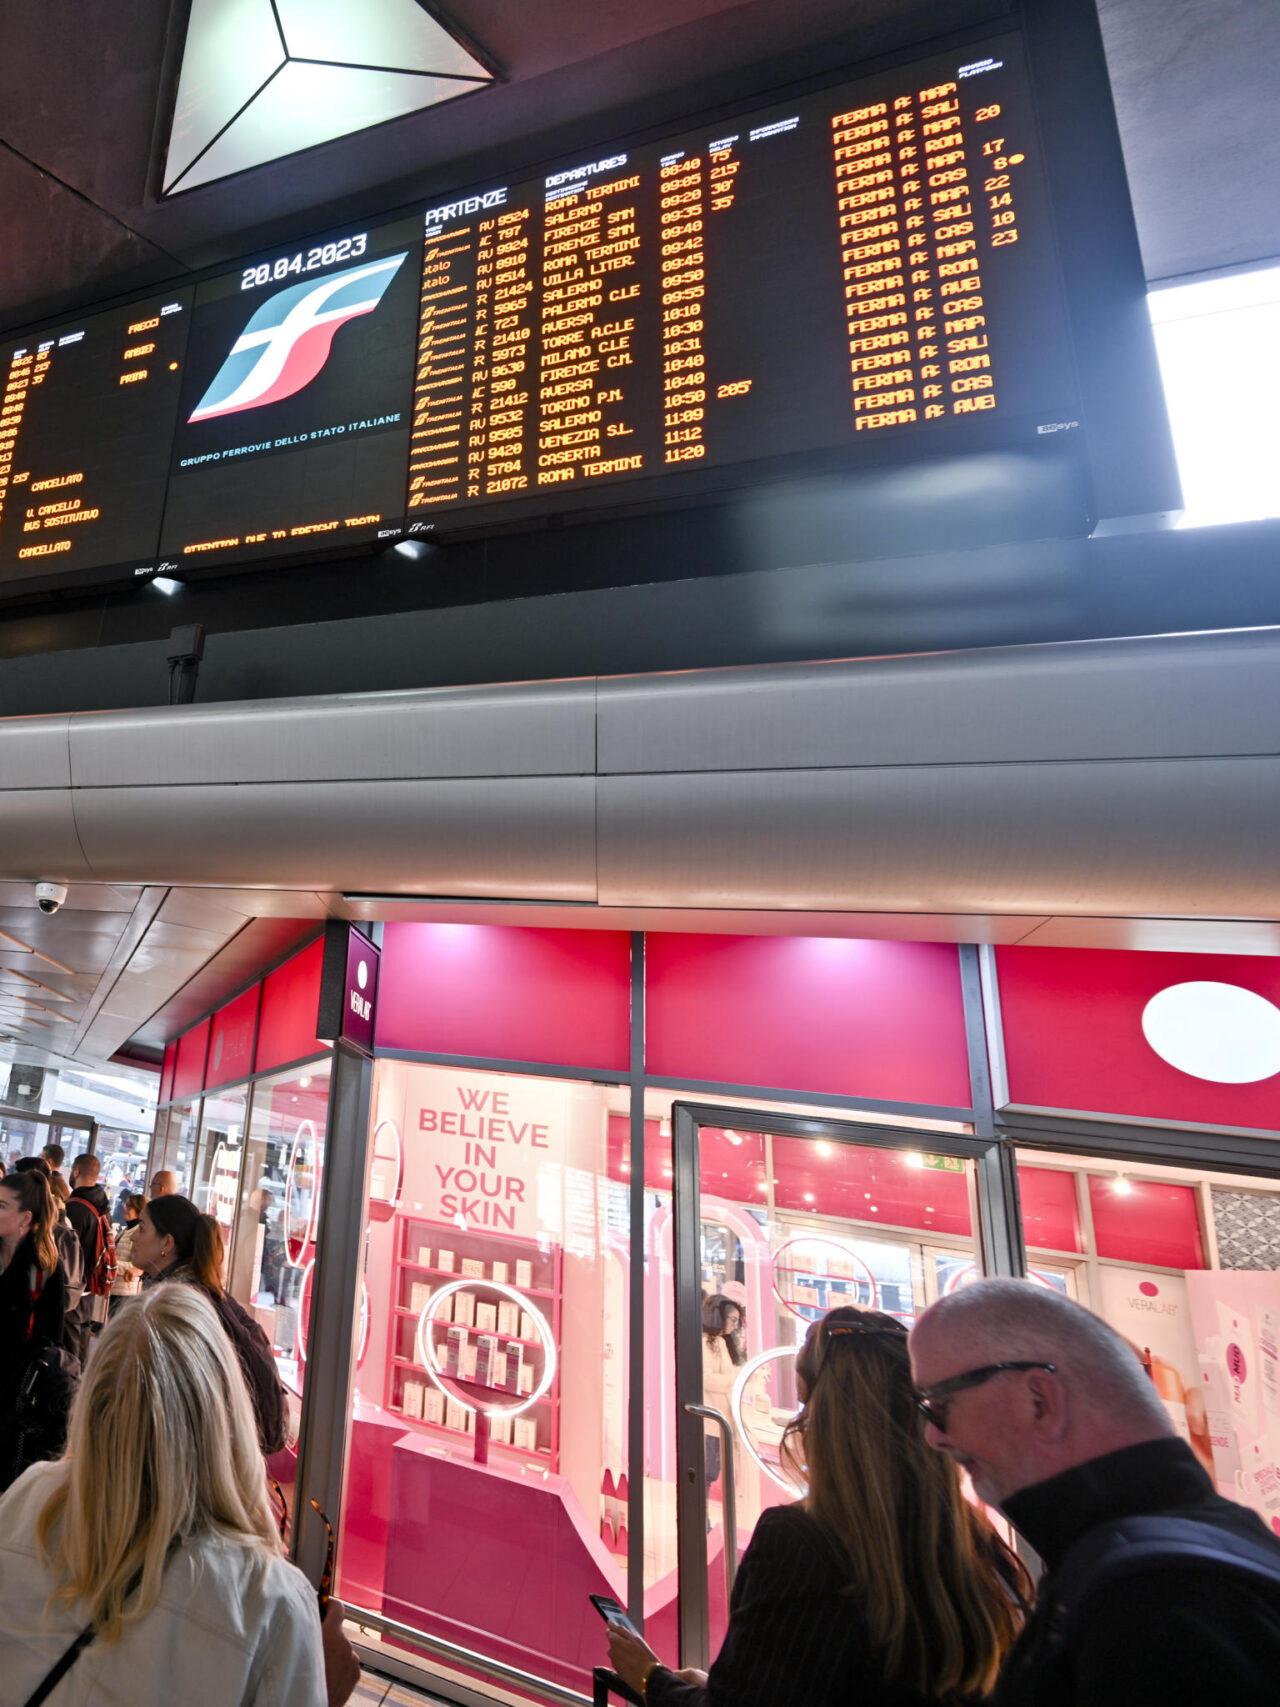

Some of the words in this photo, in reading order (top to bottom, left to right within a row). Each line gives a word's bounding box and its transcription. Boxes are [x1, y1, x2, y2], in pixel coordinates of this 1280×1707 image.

[477, 248, 494, 262] AV
[496, 237, 529, 256] 9924
[544, 216, 601, 242] FIRENZE
[607, 207, 635, 224] SMN
[660, 188, 702, 209] 09:20
[834, 135, 891, 161] FERMA
[975, 104, 1001, 122] 20
[479, 219, 495, 233] AV
[497, 208, 530, 227] 9524
[544, 194, 579, 213] ROMA
[585, 175, 640, 201] TERMINI
[660, 157, 701, 179] 08:40
[831, 102, 887, 129] FERMA
[479, 234, 492, 247] IC
[497, 224, 522, 241] 797
[544, 201, 603, 227] SALERNO
[660, 172, 702, 194] 09:05
[832, 119, 889, 145] FERMA
[545, 153, 629, 188] DEPARTURES
[425, 187, 508, 226] PARTENZE
[476, 262, 494, 276] AV
[495, 252, 527, 270] 8910
[543, 231, 601, 257] FIRENZE
[607, 222, 635, 239] SMN
[660, 203, 703, 225] 09:35
[835, 152, 892, 178] FERMA
[476, 277, 493, 291] AV
[495, 267, 526, 285] 9514
[543, 254, 578, 273] ROMA
[584, 236, 641, 261] TERMINI
[661, 219, 703, 241] 09:40
[836, 169, 894, 195] FERMA
[982, 138, 1005, 156] 17
[476, 293, 488, 306] R
[494, 280, 534, 301] 21424
[542, 267, 584, 287] VILLA
[661, 236, 704, 257] 09:42
[838, 186, 896, 211] FERMA
[993, 156, 1008, 171] 8
[240, 233, 368, 291] 20.04.2023
[474, 323, 489, 337] IC
[493, 314, 519, 331] 723
[541, 294, 603, 319] PALERMO
[661, 268, 705, 289] 09:50
[840, 220, 899, 246] FERMA
[989, 192, 1013, 210] 14
[475, 309, 488, 321] R
[494, 297, 528, 316] 5965
[542, 278, 603, 303] SALERNO
[661, 251, 704, 273] 09:45
[839, 203, 897, 228] FERMA
[984, 174, 1011, 192] 22
[473, 354, 486, 367] R
[492, 344, 526, 362] 5973
[541, 330, 584, 351] TORRE
[662, 303, 701, 323] 10:10
[843, 256, 903, 281] FERMA
[991, 228, 1018, 247] 23
[474, 339, 486, 352] R
[492, 327, 531, 347] 21410
[541, 312, 594, 335] AVERSA
[662, 284, 705, 305] 09:55
[842, 238, 901, 263] FERMA
[992, 210, 1016, 228] 10
[471, 369, 489, 383] AV
[491, 360, 526, 378] 9630
[540, 345, 592, 367] MILANO
[663, 319, 704, 339] 10:30
[845, 274, 904, 299] FERMA
[471, 386, 486, 399] IC
[490, 378, 517, 394] 590
[540, 359, 600, 383] FIRENZE
[663, 337, 702, 356] 10:31
[471, 402, 483, 415] R
[489, 391, 529, 410] 21412
[539, 377, 594, 400] AVERSA
[663, 354, 705, 374] 10:40
[468, 434, 486, 448] AV
[488, 425, 524, 443] 9505
[539, 410, 602, 433] SALERNO
[664, 389, 706, 409] 10:50
[469, 417, 487, 431] AV
[489, 409, 524, 426] 9532
[539, 395, 591, 416] TORINO
[664, 371, 706, 391] 10:40
[180, 451, 221, 468] GRUPPO
[221, 441, 272, 459] FERROVIE
[274, 433, 308, 448] DELLO
[310, 424, 345, 440] STATO
[348, 413, 401, 432] ITALIANE
[467, 450, 485, 464] AV
[487, 442, 523, 460] 9420
[538, 427, 600, 450] VENEZIA
[664, 407, 705, 427] 11:09
[467, 467, 481, 481] R
[487, 459, 522, 477] 5784
[538, 444, 601, 467] CASERTA
[664, 426, 703, 445] 11:12
[31, 472, 84, 492] CANCELLATO
[467, 484, 480, 497] R
[486, 475, 528, 494] 21072
[537, 467, 575, 485] ROMA
[581, 454, 643, 477] TERMINI
[664, 444, 705, 463] 11:20
[23, 519, 41, 532] BUS
[43, 508, 99, 528] SOSTITUTIVO
[37, 499, 81, 516] CANCELLO
[18, 540, 72, 559] CANCELLATO
[419, 1109, 549, 1148] BELIEVE
[457, 1087, 509, 1115] WE
[435, 1165, 525, 1203] YOUR
[465, 1142, 496, 1168] IN
[440, 1195, 515, 1230] SKIN
